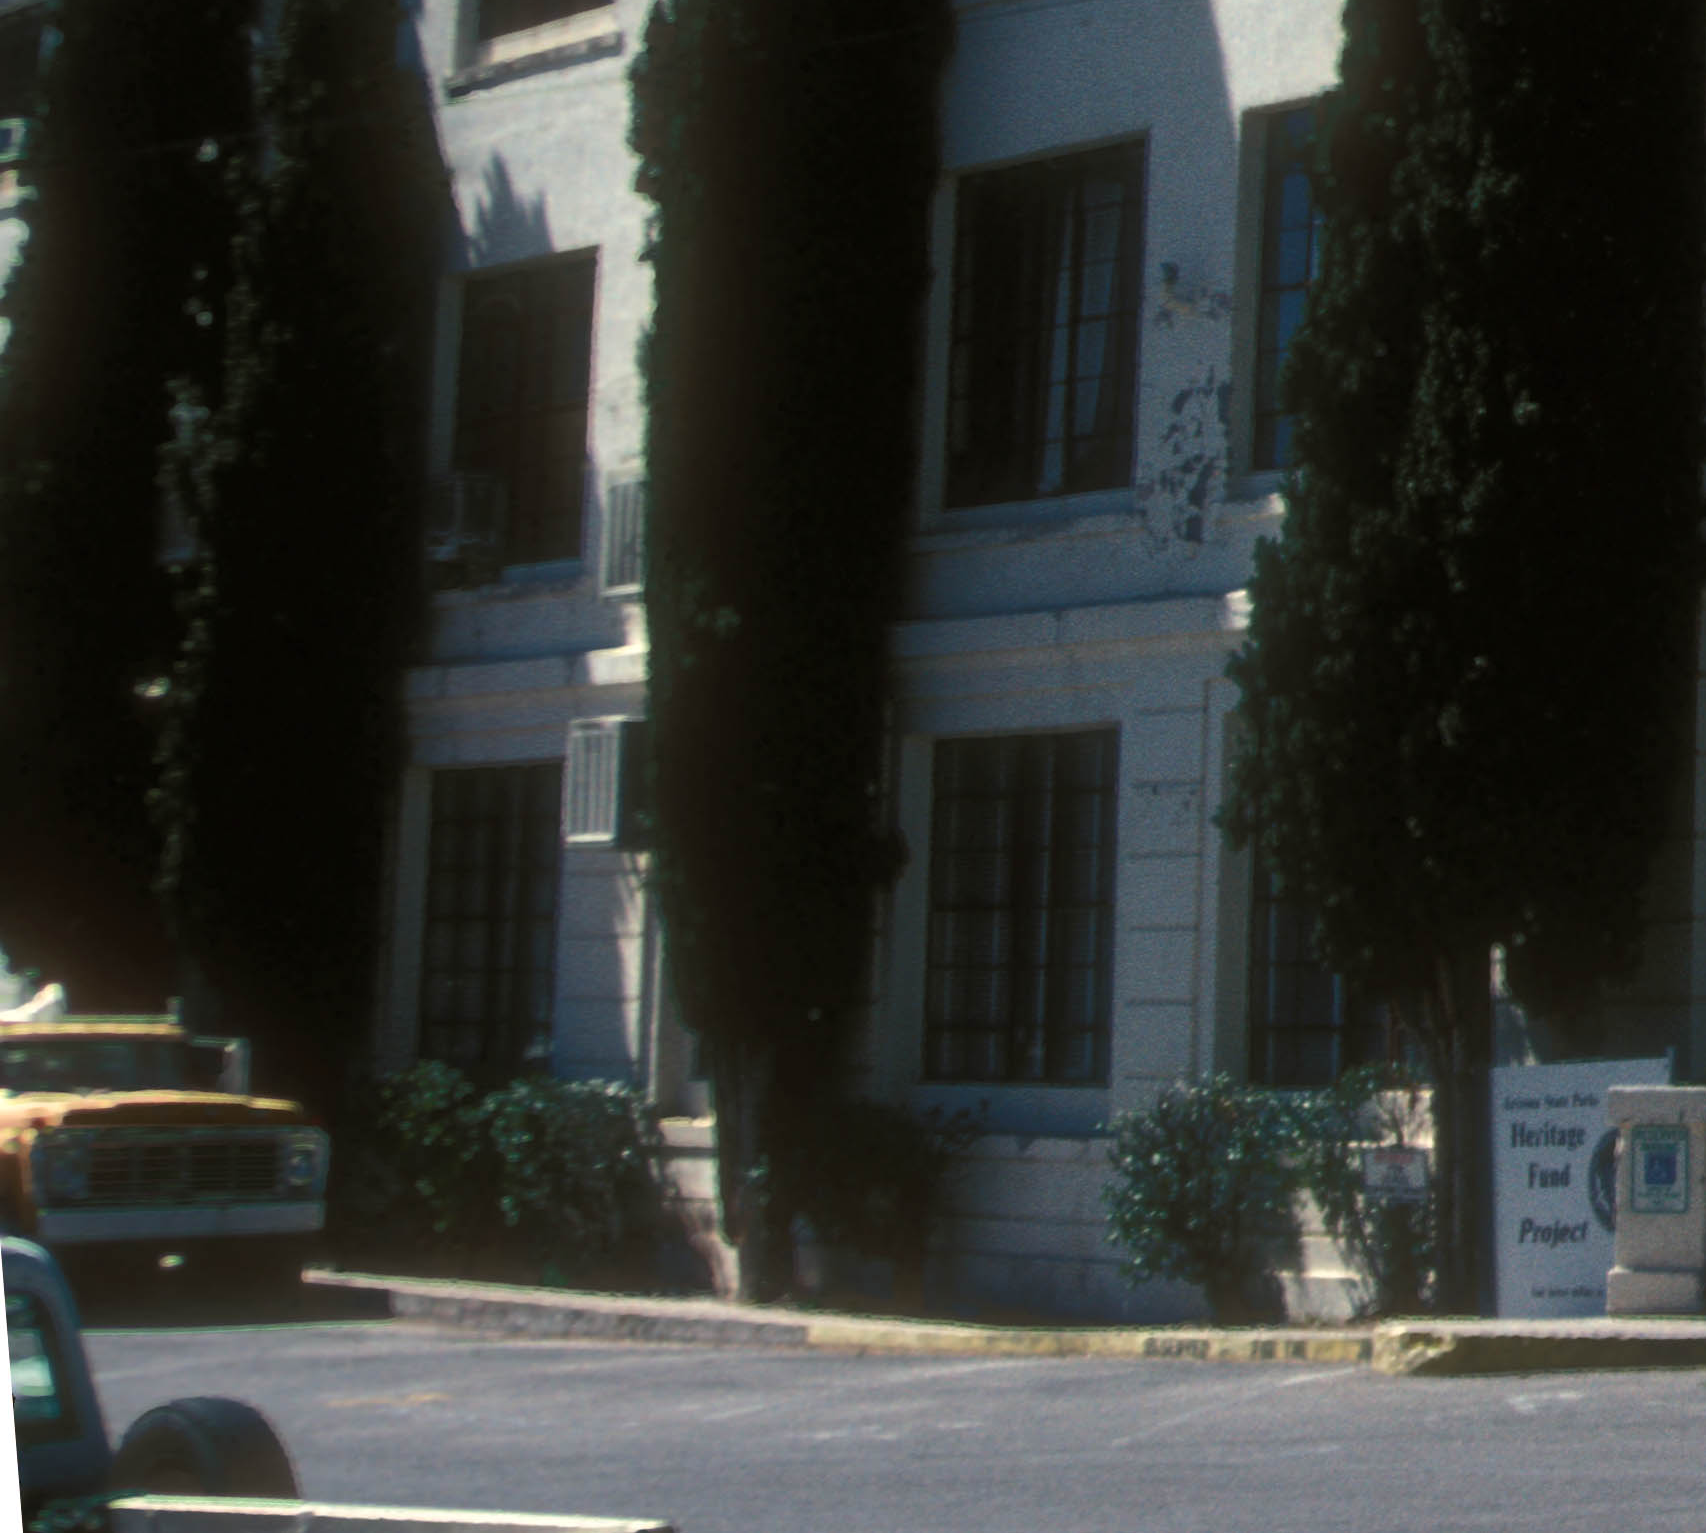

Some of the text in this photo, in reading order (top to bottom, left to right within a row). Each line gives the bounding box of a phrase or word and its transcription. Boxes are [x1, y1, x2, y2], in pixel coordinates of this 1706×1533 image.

[1511, 1122, 1586, 1151] Heritage
[1528, 1163, 1571, 1188] Fund
[1517, 1219, 1589, 1249] Project
